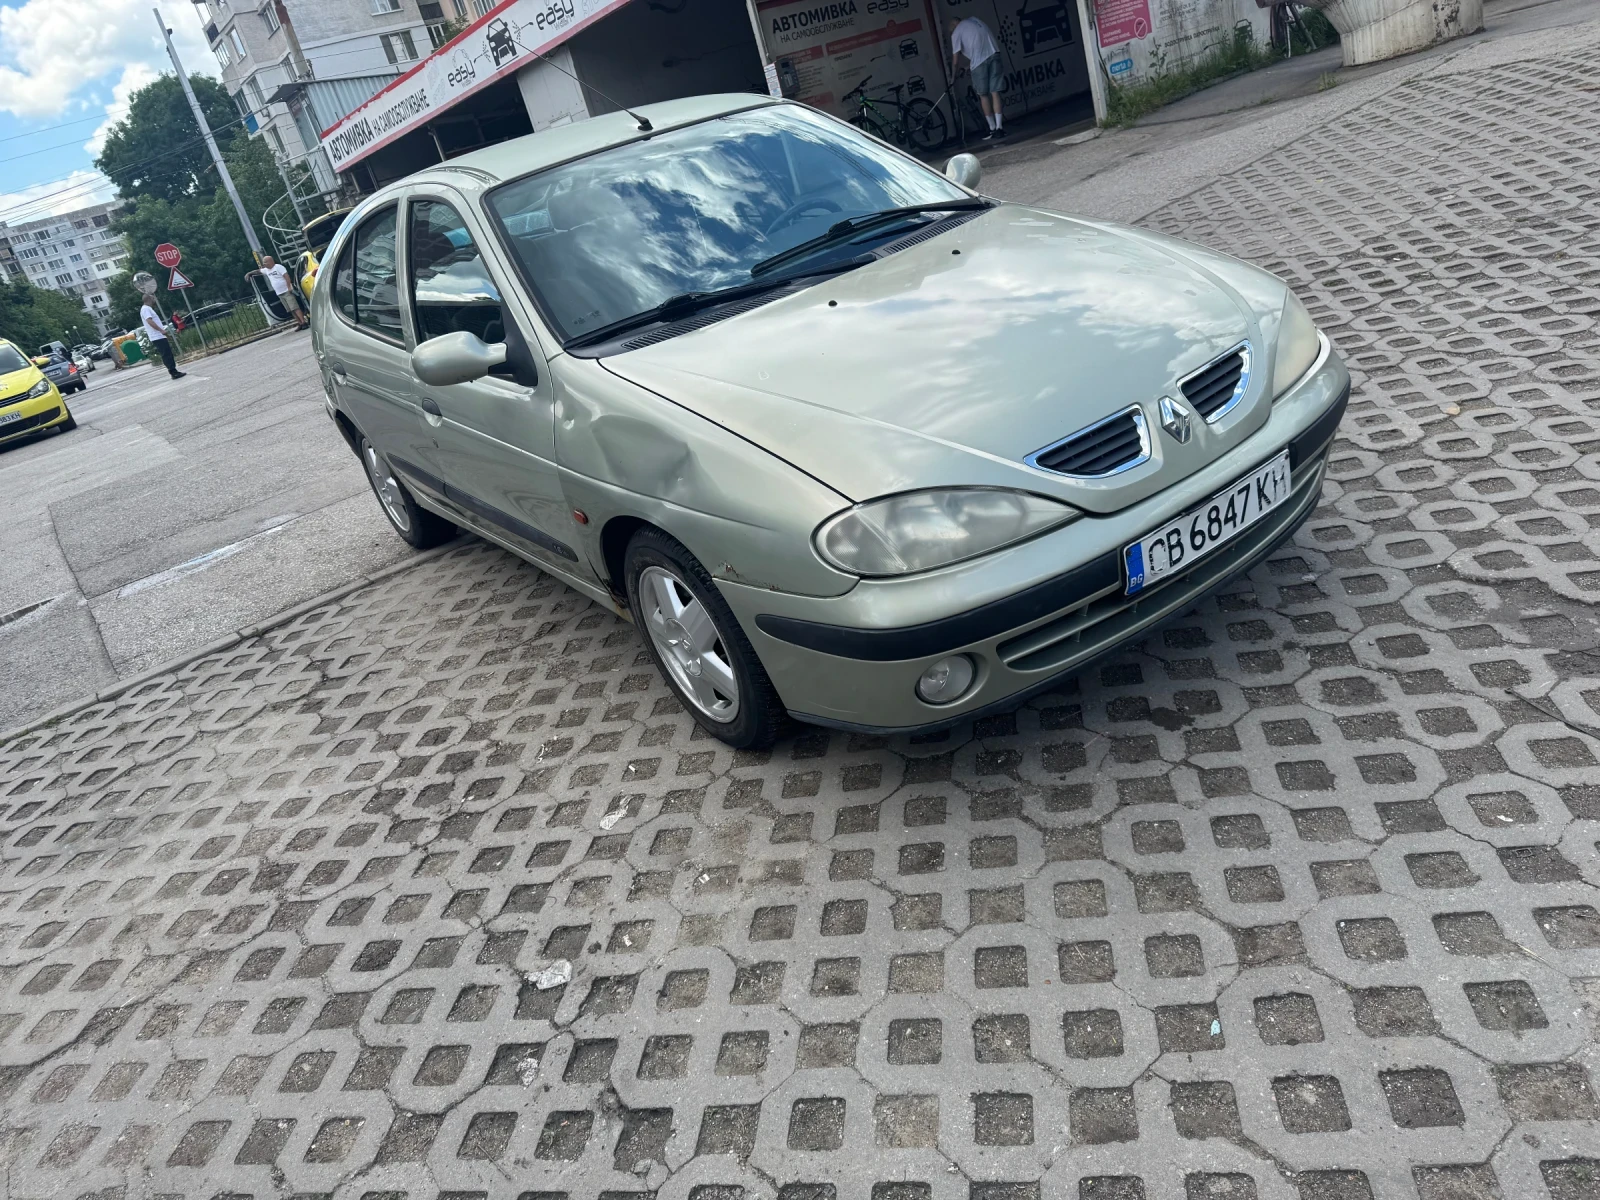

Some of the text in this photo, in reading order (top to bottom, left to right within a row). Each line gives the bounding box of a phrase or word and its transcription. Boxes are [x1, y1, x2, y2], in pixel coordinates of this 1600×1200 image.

[536, 0, 575, 31] easy
[772, 0, 858, 34] АВТОМИВКА
[780, 18, 855, 43] НА САМООБСЛУЖВАНЕ
[447, 60, 476, 87] easy
[329, 117, 375, 163] АВТОМИВКА
[157, 249, 178, 261] STOP
[1130, 573, 1143, 588] BG
